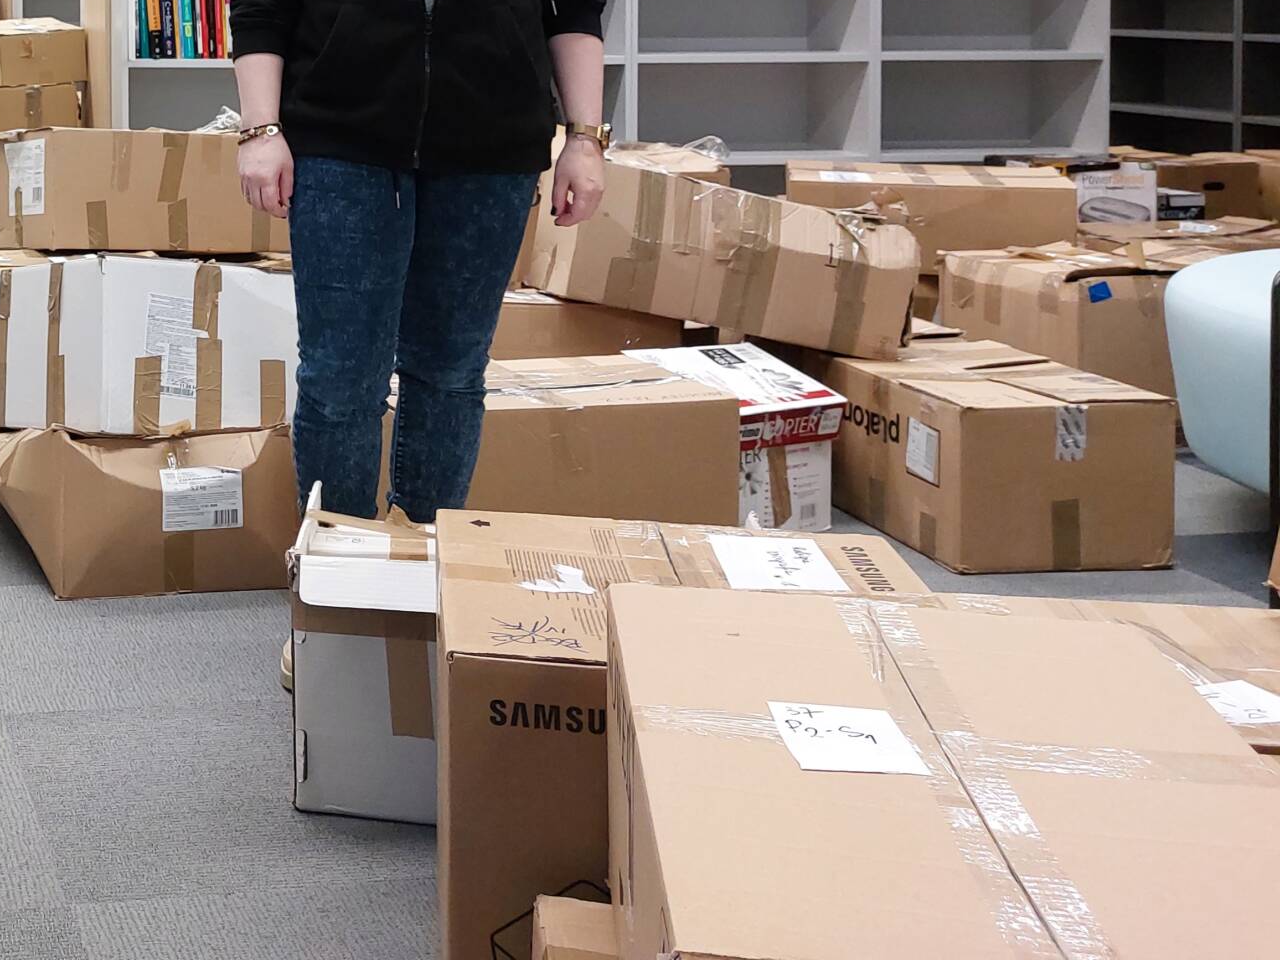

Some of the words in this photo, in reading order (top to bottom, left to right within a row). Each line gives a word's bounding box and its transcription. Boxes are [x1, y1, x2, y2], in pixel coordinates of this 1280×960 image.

[842, 402, 901, 445] platon
[840, 546, 896, 592] SAMSUNG
[489, 699, 606, 735] SAMSU
